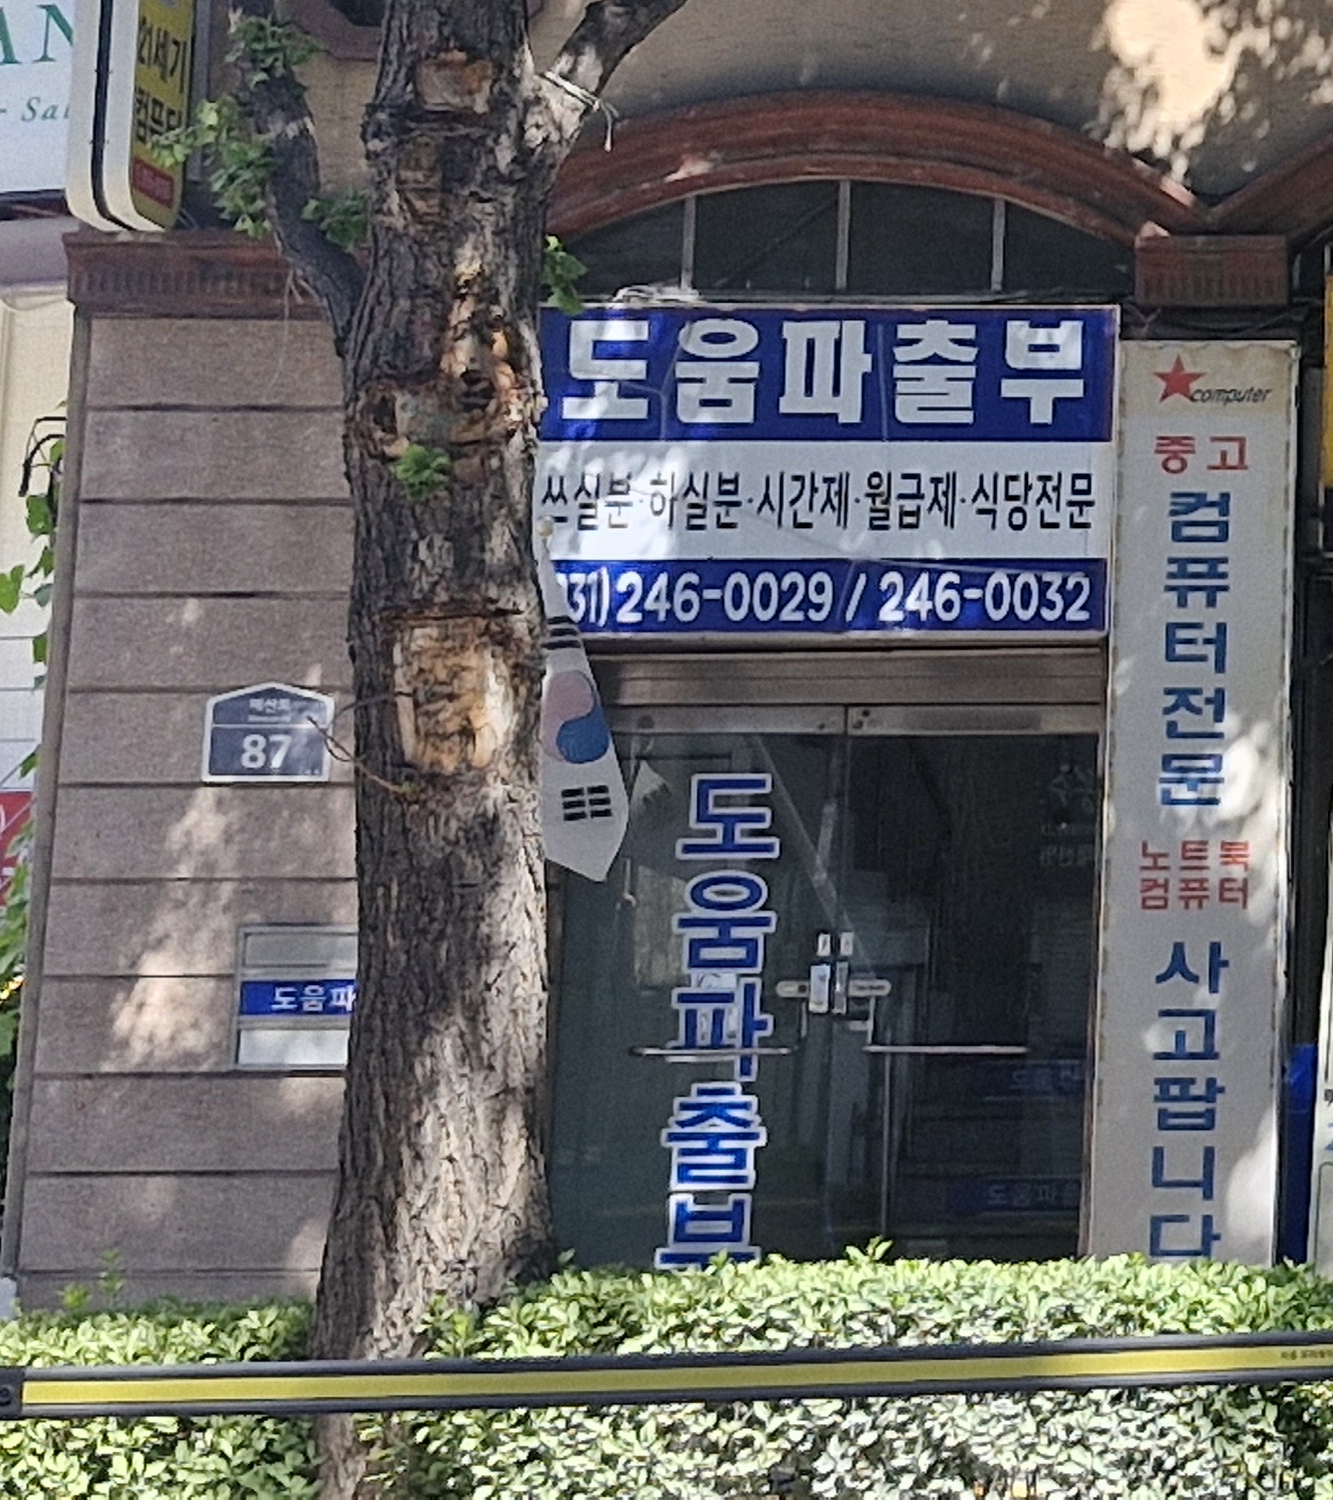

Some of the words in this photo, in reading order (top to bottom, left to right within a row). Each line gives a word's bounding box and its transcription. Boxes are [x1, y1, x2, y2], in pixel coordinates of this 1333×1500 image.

[561, 317, 1085, 425] 도움파출부
[1189, 386, 1272, 406] computer
[1153, 435, 1249, 476] 중고
[879, 571, 1091, 623] 246-0032
[1158, 491, 1232, 806] 컴퓨터전문
[241, 733, 292, 770] 87
[1138, 839, 1251, 872] 노트북
[1138, 877, 1250, 911] 컴퓨터
[654, 772, 780, 1270] 도움파출부
[1148, 940, 1230, 1259] 사고팝니다
